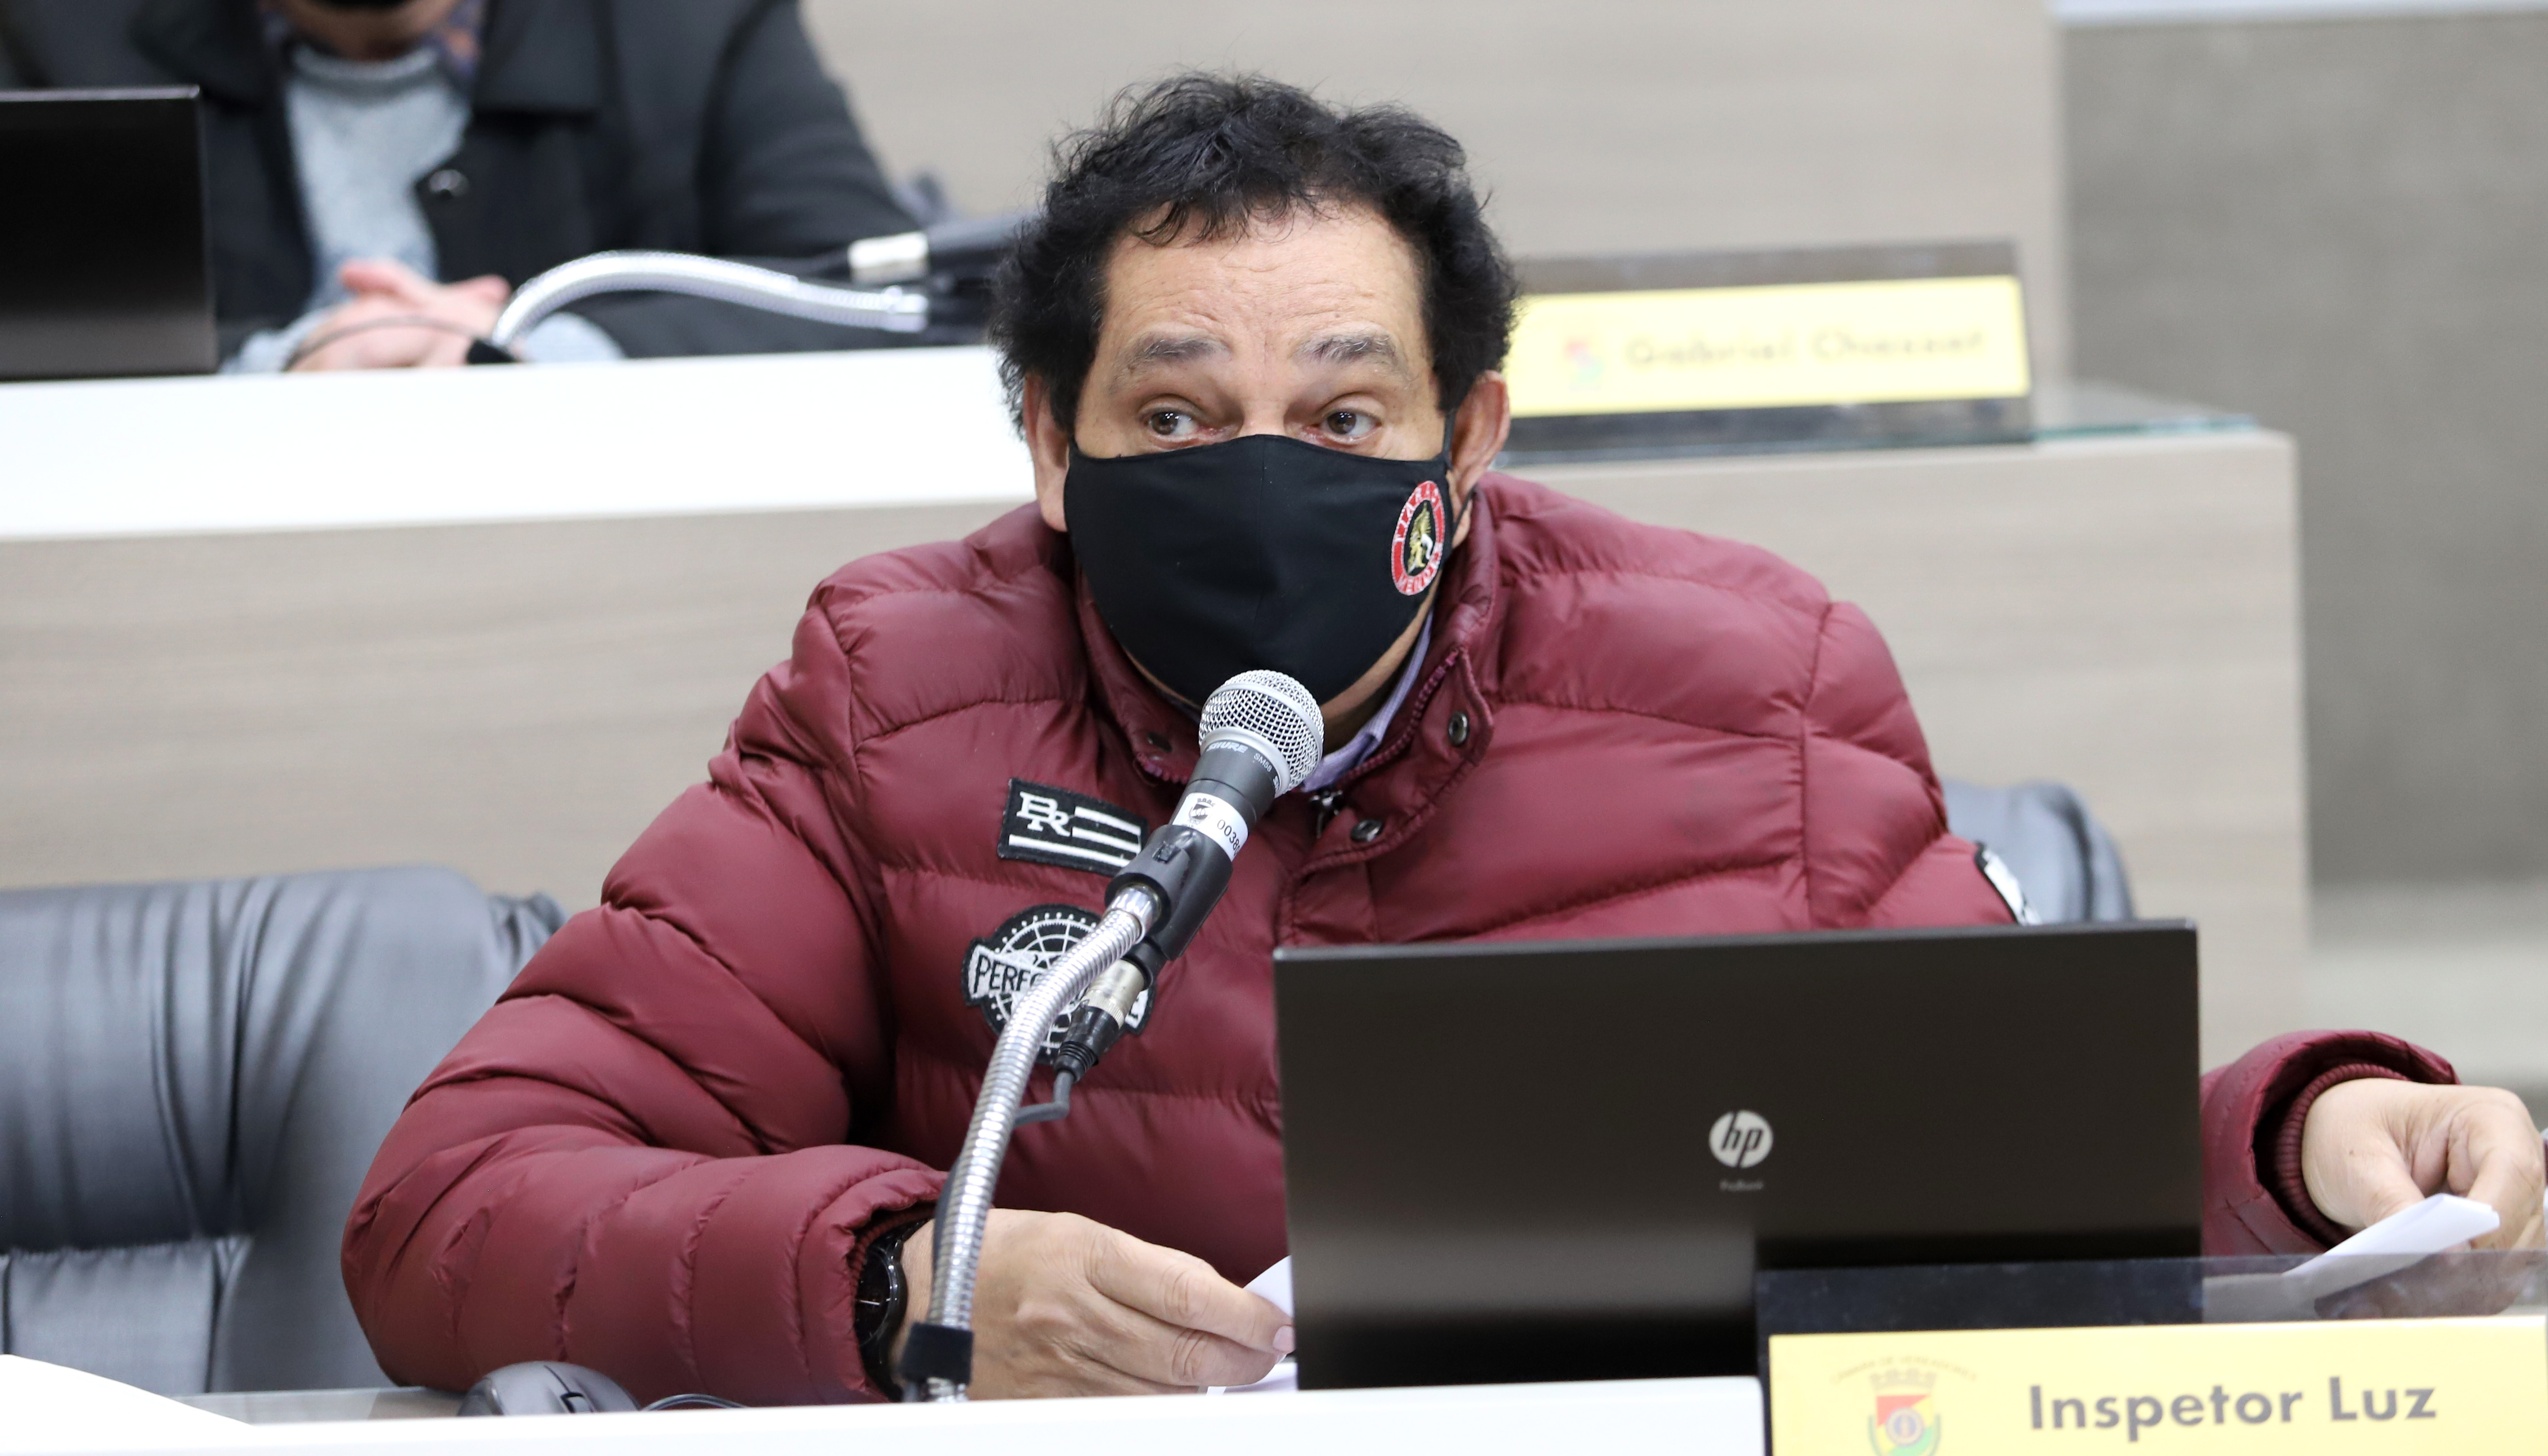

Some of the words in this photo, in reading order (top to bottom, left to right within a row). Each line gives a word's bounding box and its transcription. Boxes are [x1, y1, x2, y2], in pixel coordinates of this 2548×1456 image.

[1254, 753, 1272, 772] SM58
[1720, 1111, 1764, 1168] hp
[2030, 1384, 2303, 1443] Inspetor
[2328, 1376, 2436, 1422] Luz
